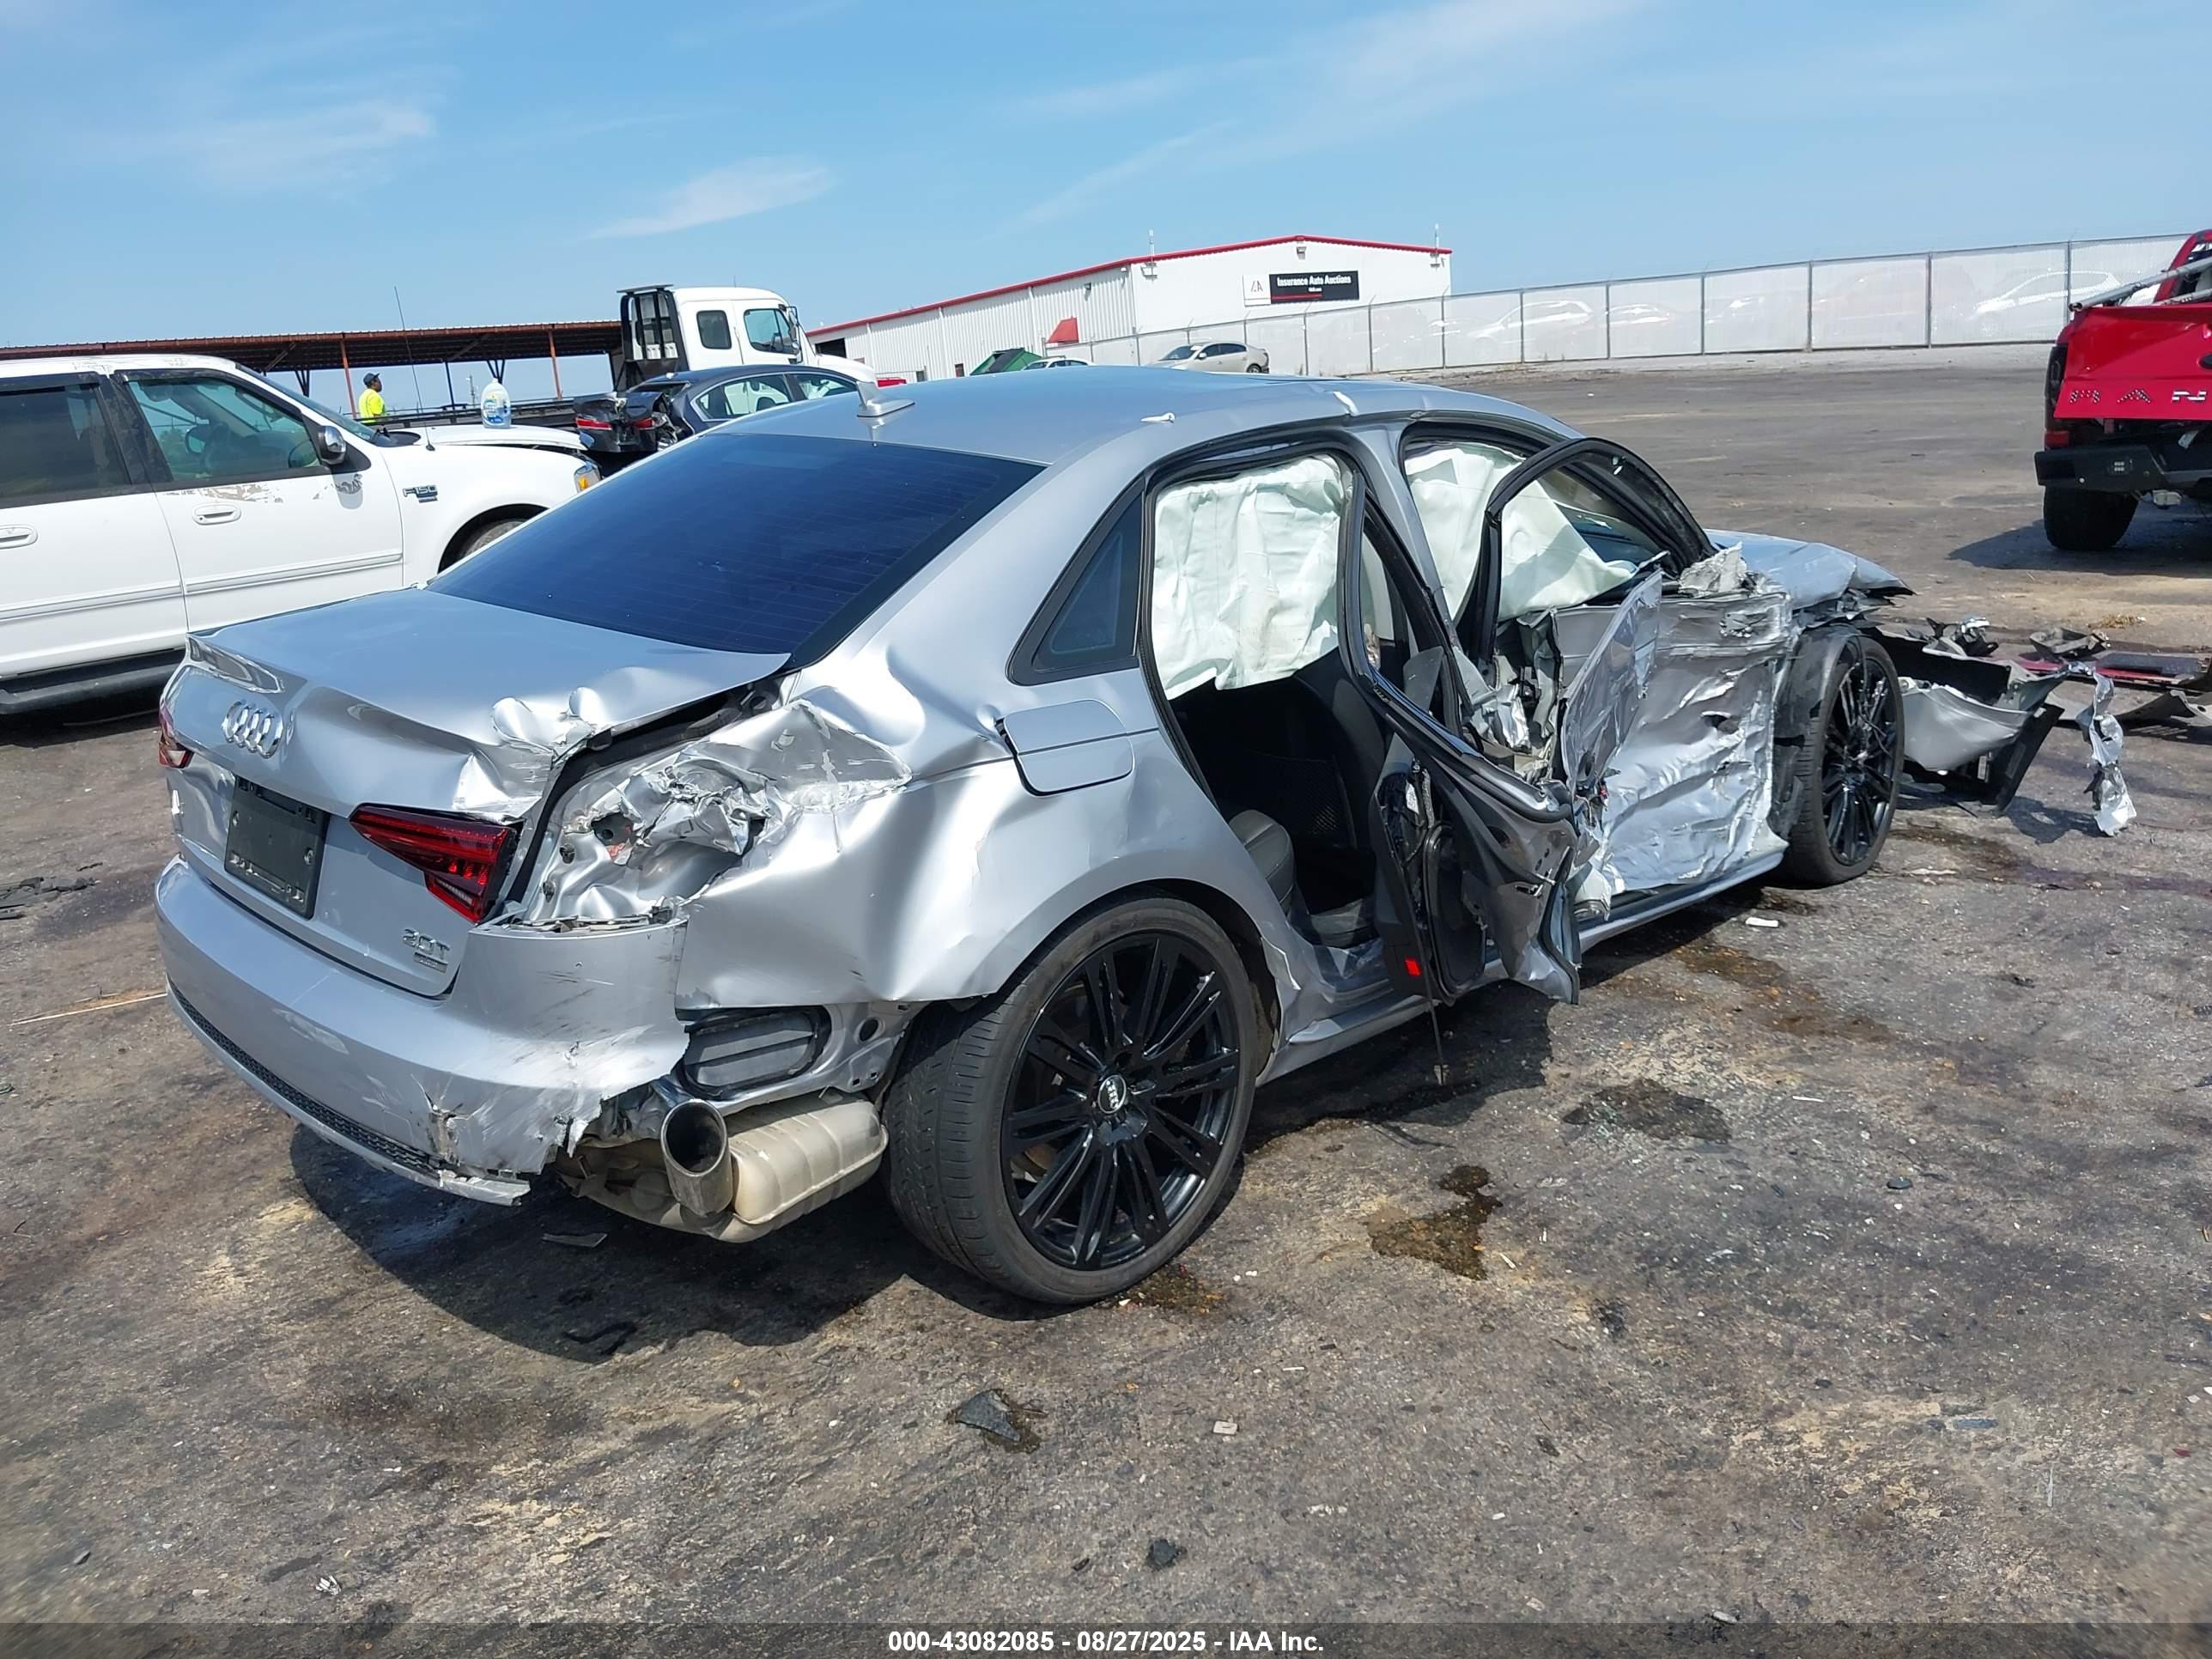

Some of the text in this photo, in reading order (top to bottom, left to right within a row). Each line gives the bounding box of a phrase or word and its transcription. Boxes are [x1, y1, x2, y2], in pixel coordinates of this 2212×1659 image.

[1277, 275, 1352, 287] Insurance Auto Auctions
